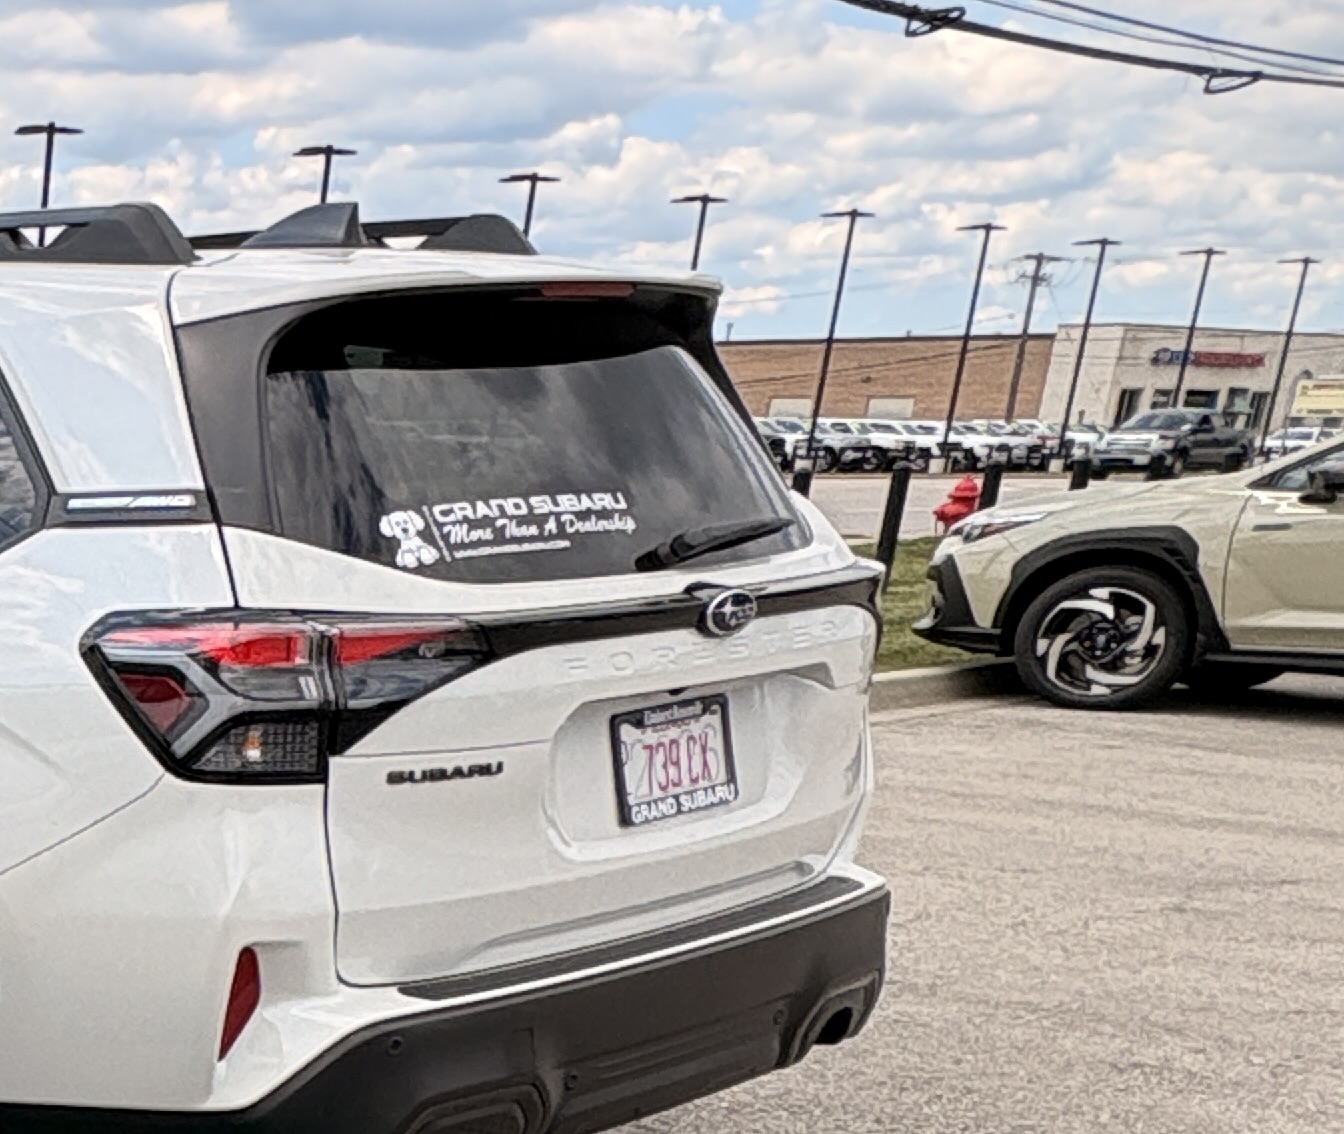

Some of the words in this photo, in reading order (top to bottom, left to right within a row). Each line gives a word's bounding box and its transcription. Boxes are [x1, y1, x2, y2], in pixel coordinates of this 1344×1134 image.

[433, 497, 528, 523] GRAND
[529, 491, 628, 514] SUBARU
[443, 525, 494, 544] More
[495, 518, 539, 538] Than
[543, 515, 558, 536] A
[387, 761, 503, 785] SUBARU
[641, 737, 682, 798] 739
[687, 731, 712, 785] CX
[632, 797, 677, 823] GRAND
[679, 783, 735, 811] SUBARU
